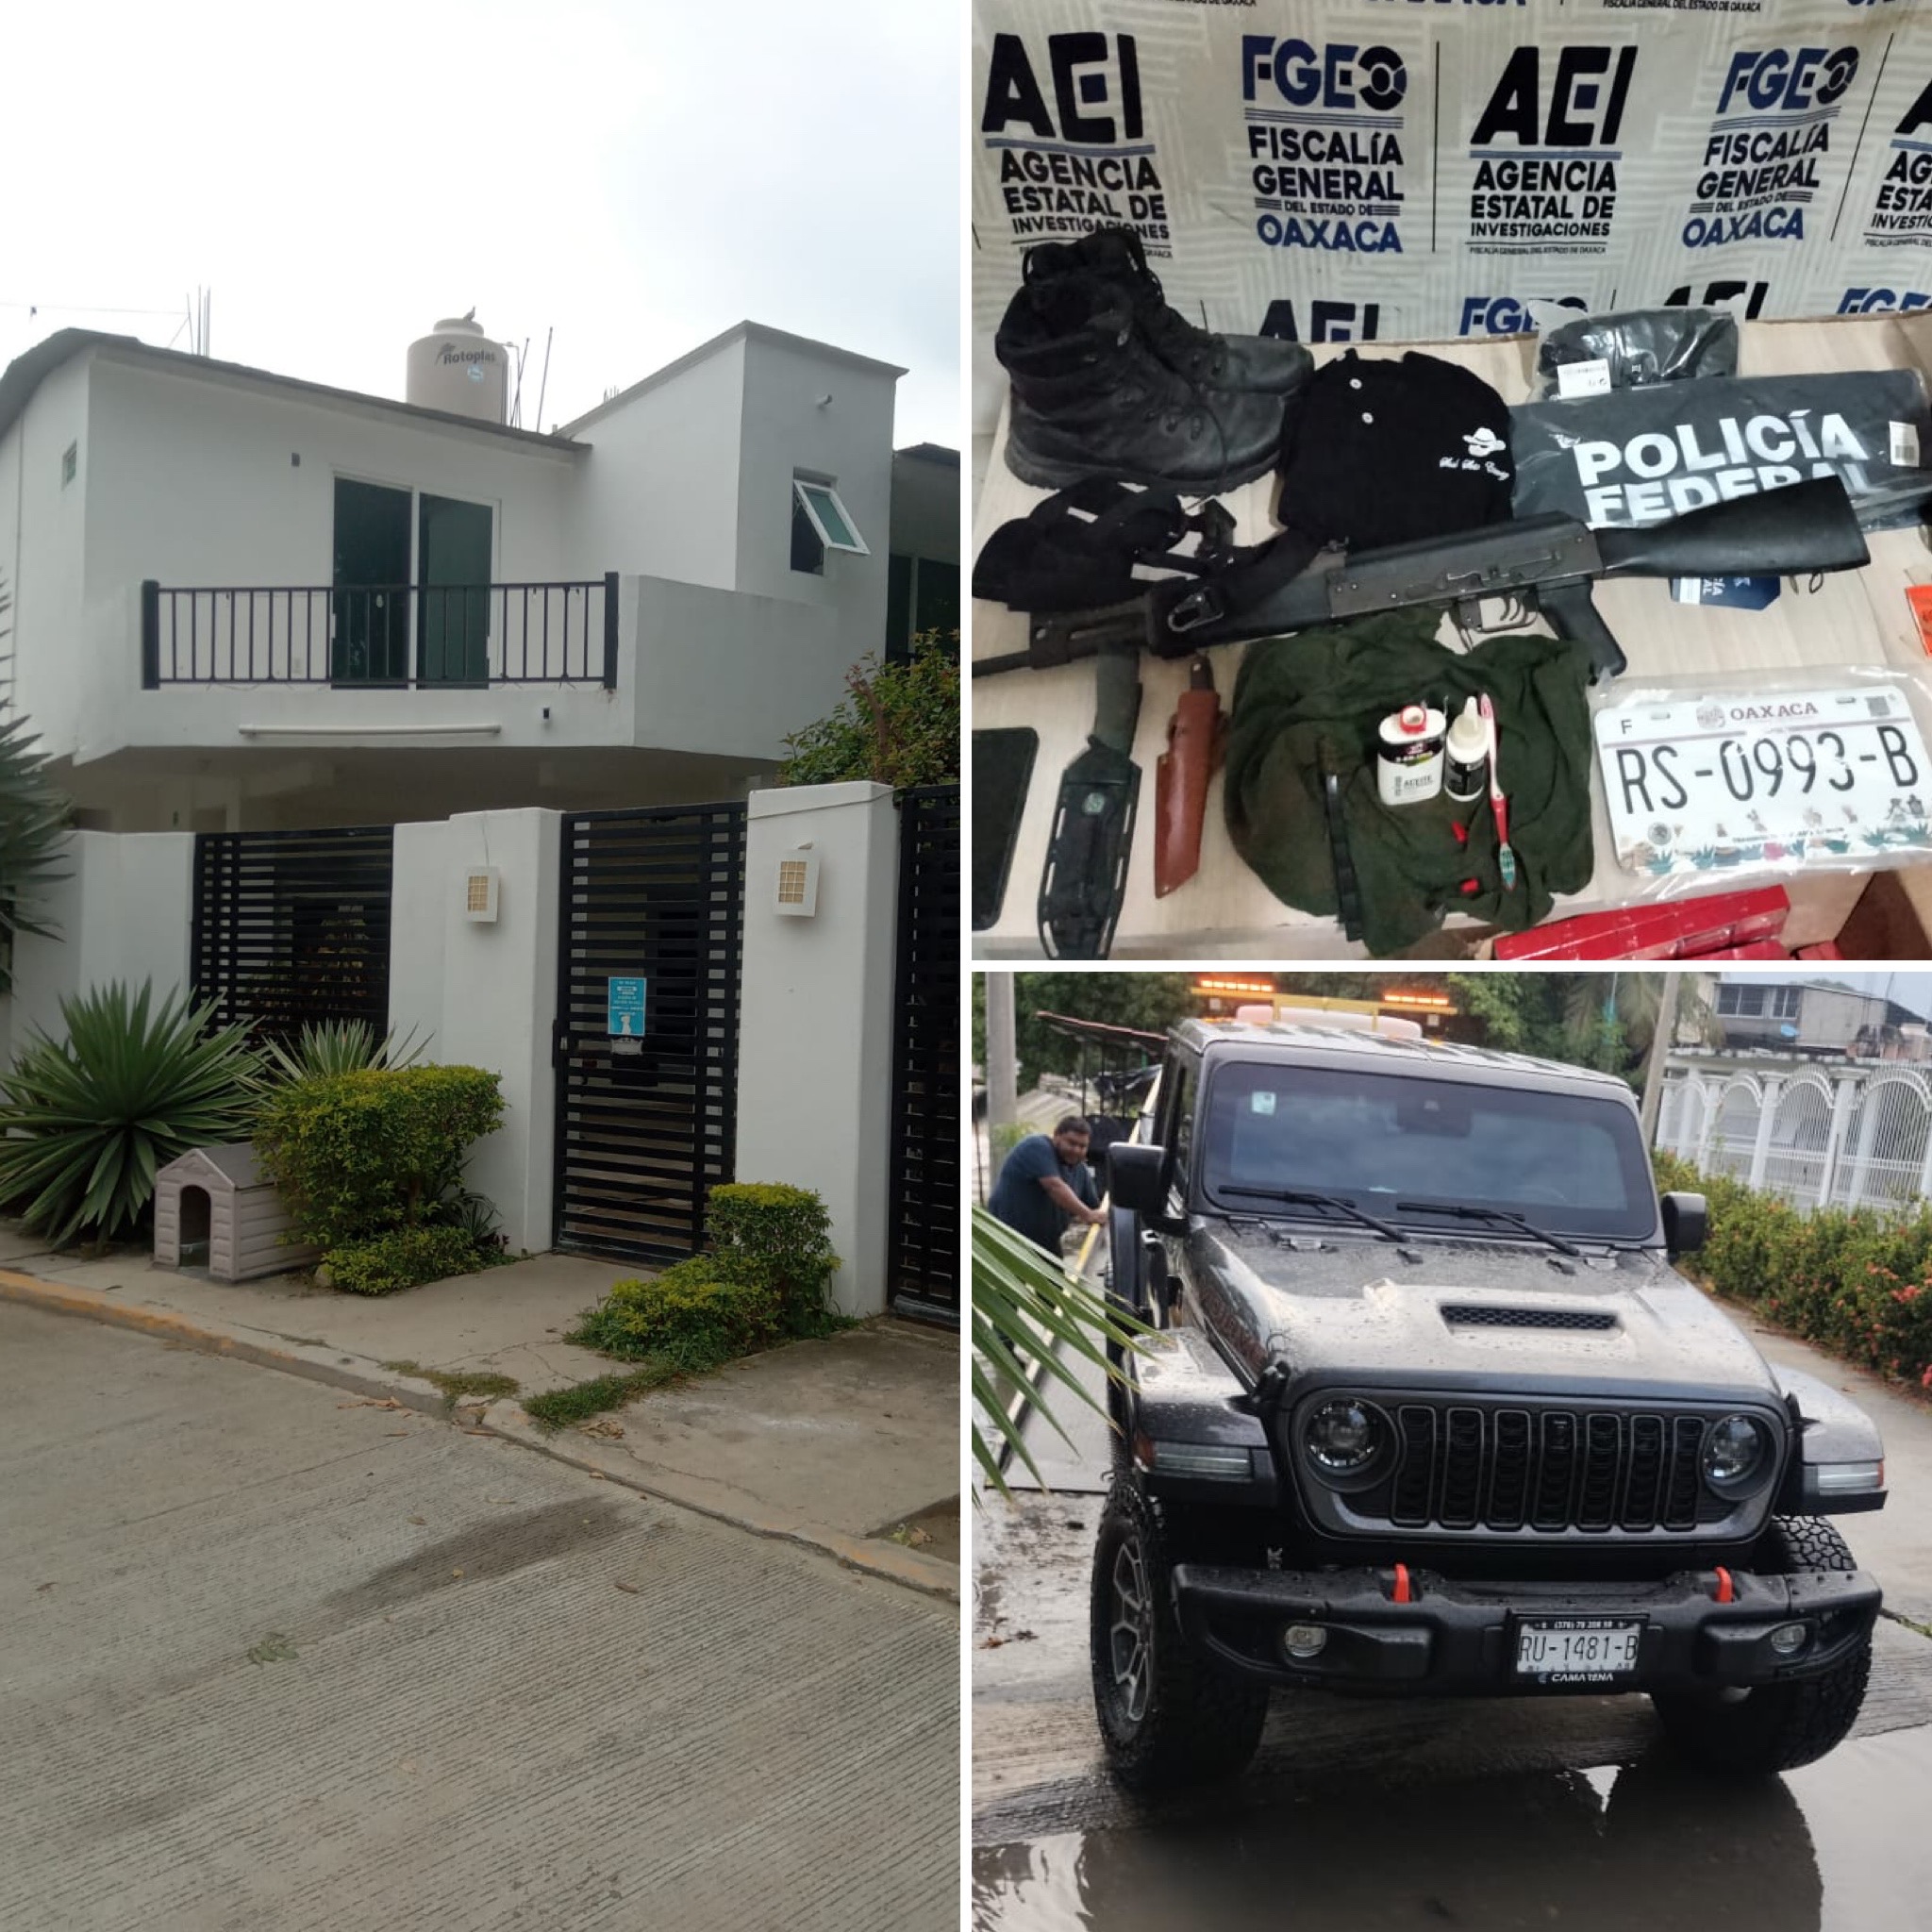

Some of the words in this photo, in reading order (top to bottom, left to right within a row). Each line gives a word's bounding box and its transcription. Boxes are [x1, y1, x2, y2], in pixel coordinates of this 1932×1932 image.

[982, 32, 1143, 144] AEI
[1242, 35, 1407, 110] FGEO
[1716, 46, 1859, 114] FGEO
[1470, 45, 1638, 146] AEI
[1248, 125, 1404, 165] FISCALÍA
[1704, 124, 1828, 167] FISCALÍA
[1001, 149, 1161, 191] AGENCIA
[1253, 164, 1404, 201] GENERAL
[1473, 160, 1617, 192] AGENCIA
[1696, 158, 1820, 200] GENERAL
[1885, 151, 1932, 185] AG
[1002, 186, 1123, 219] ESTATAL
[1128, 193, 1167, 221] DE
[1284, 201, 1307, 213] DEL
[1310, 202, 1356, 216] ESTADO
[1471, 195, 1574, 219] ESTATAL
[1583, 195, 1614, 219] DE
[1716, 202, 1734, 213] DEL
[1738, 193, 1773, 211] ESTADO
[1257, 214, 1403, 253] OAXACA
[1471, 222, 1610, 237] INVESTIGACIONES
[1682, 207, 1803, 247] OAXACA
[1574, 408, 1869, 487] POLICÍA
[1621, 719, 1633, 734] F
[1730, 702, 1818, 721] OAXACA
[1616, 725, 1919, 815] RS-0993-B
[1518, 1635, 1639, 1662] RU-1481-B
